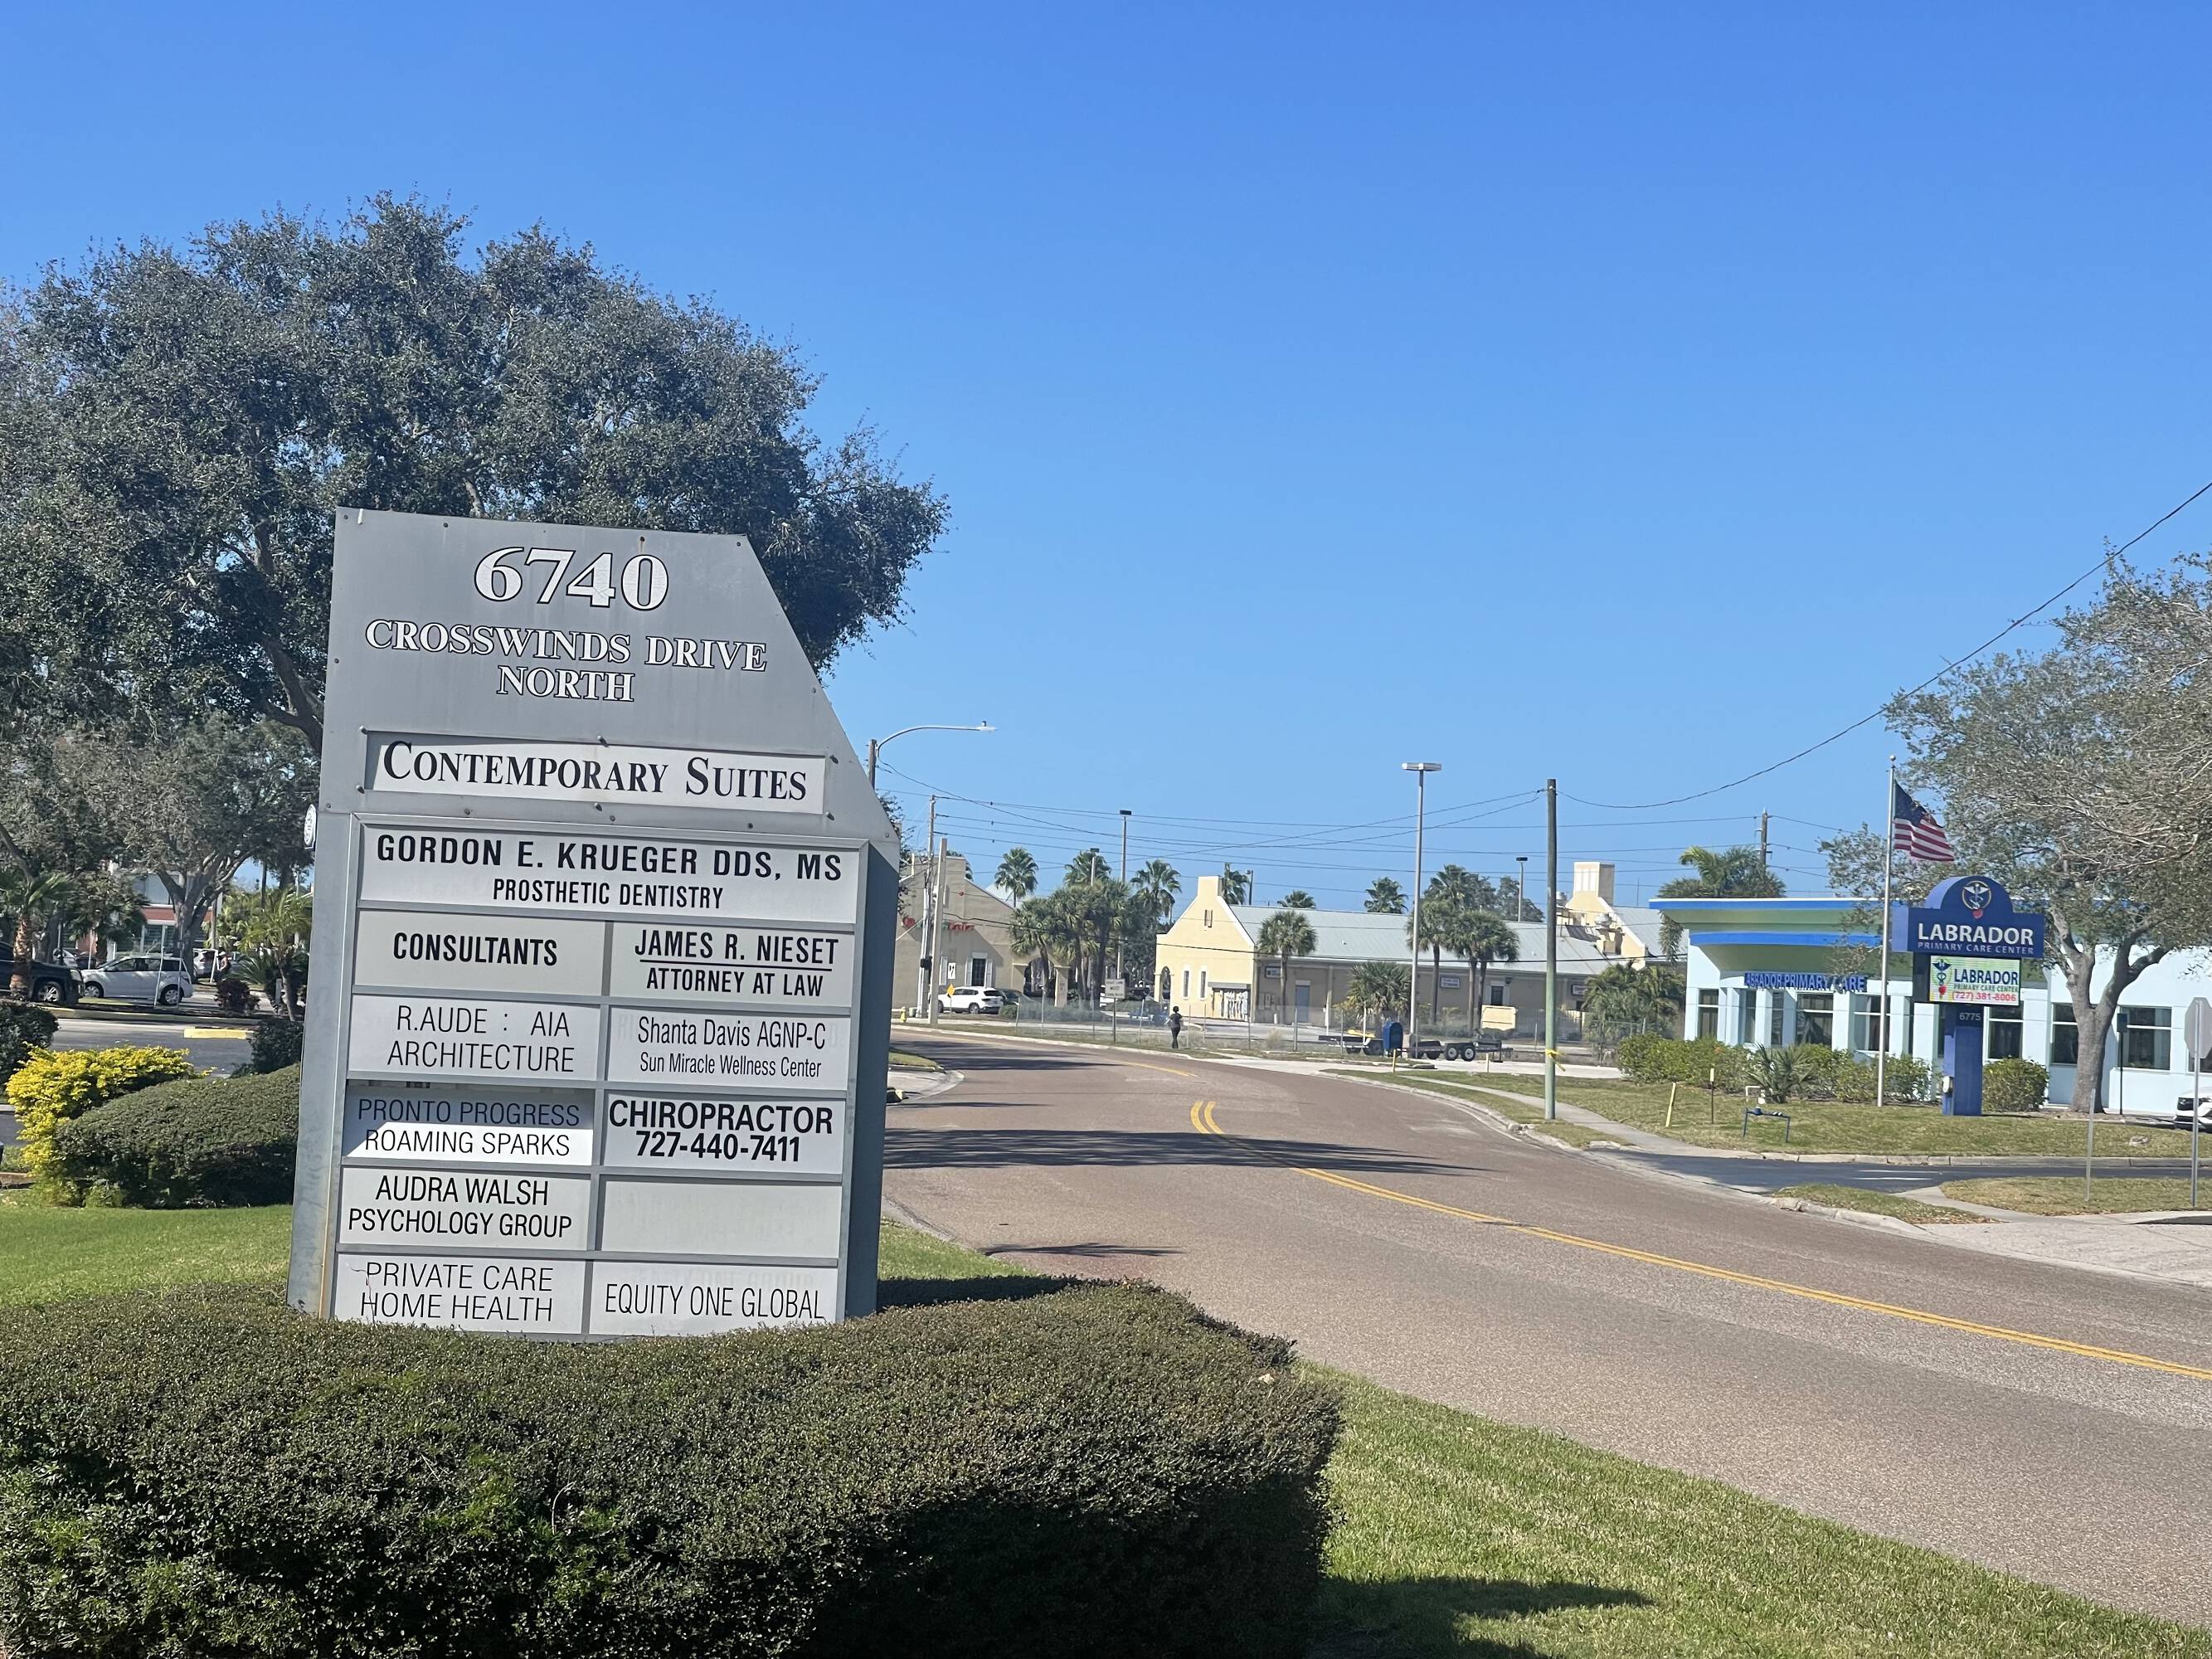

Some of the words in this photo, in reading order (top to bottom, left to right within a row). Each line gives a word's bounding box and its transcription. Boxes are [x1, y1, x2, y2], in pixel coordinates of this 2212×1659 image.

[474, 547, 668, 611] 6740
[366, 619, 630, 664] CROSSWINDS
[645, 636, 767, 672] DRIVE
[497, 665, 634, 702] NORTH
[383, 741, 668, 793] CONTEMPORARY
[686, 757, 807, 800] SUITES
[377, 834, 502, 866] GORDON
[518, 841, 542, 869] E.
[557, 844, 698, 874] KRUEGER
[712, 849, 781, 881] DDS,
[797, 854, 842, 881] MS
[493, 878, 610, 905] PROSTHETIC
[619, 884, 723, 908] DENTISTRY
[393, 932, 558, 966] CONSULTANTS
[634, 930, 713, 960] JAMES
[724, 934, 745, 961] R.
[757, 935, 839, 965] NIESET
[1918, 923, 2034, 946] LABRADOR
[1918, 942, 1962, 951] PRIMARY
[1966, 944, 1991, 952] CARE
[1996, 946, 2034, 954] CENTER
[646, 968, 744, 994] ATTORNEY
[752, 974, 775, 995] AT
[783, 975, 823, 996] LAW
[1954, 969, 2018, 985] LABRADOR
[1952, 991, 1973, 1001] (727)
[397, 1005, 488, 1034] R.AUDE
[531, 1011, 570, 1037] AIA
[638, 1016, 697, 1044] Shanta
[704, 1019, 750, 1047] Davis
[757, 1021, 826, 1049] AGNP-C
[1959, 1013, 1981, 1021] 6775
[387, 1041, 575, 1073] ARCHITECTURE
[640, 1052, 664, 1072] Sun
[669, 1053, 715, 1073] Miracle
[720, 1055, 775, 1076] Wellness
[781, 1057, 821, 1077] Center
[358, 1099, 451, 1122] PRONTO
[459, 1102, 580, 1126] PROGRESS
[609, 1099, 833, 1134] CHIROPRACTOR
[365, 1129, 473, 1153] ROAMING
[482, 1132, 570, 1156] SPARKS
[635, 1131, 800, 1162] 727-440-7411
[376, 1175, 459, 1203] AUDRA
[465, 1179, 548, 1206] WALSH
[348, 1210, 493, 1236] PSYCHOLOGY
[499, 1214, 572, 1238] GROUP
[365, 1262, 474, 1289] PRIVATE
[483, 1265, 554, 1292] CARE
[360, 1292, 442, 1319] HOME
[452, 1294, 552, 1321] HEALTH
[605, 1283, 683, 1314] EQUITY
[690, 1286, 733, 1316] ONE
[741, 1287, 824, 1319] GLOBAL
